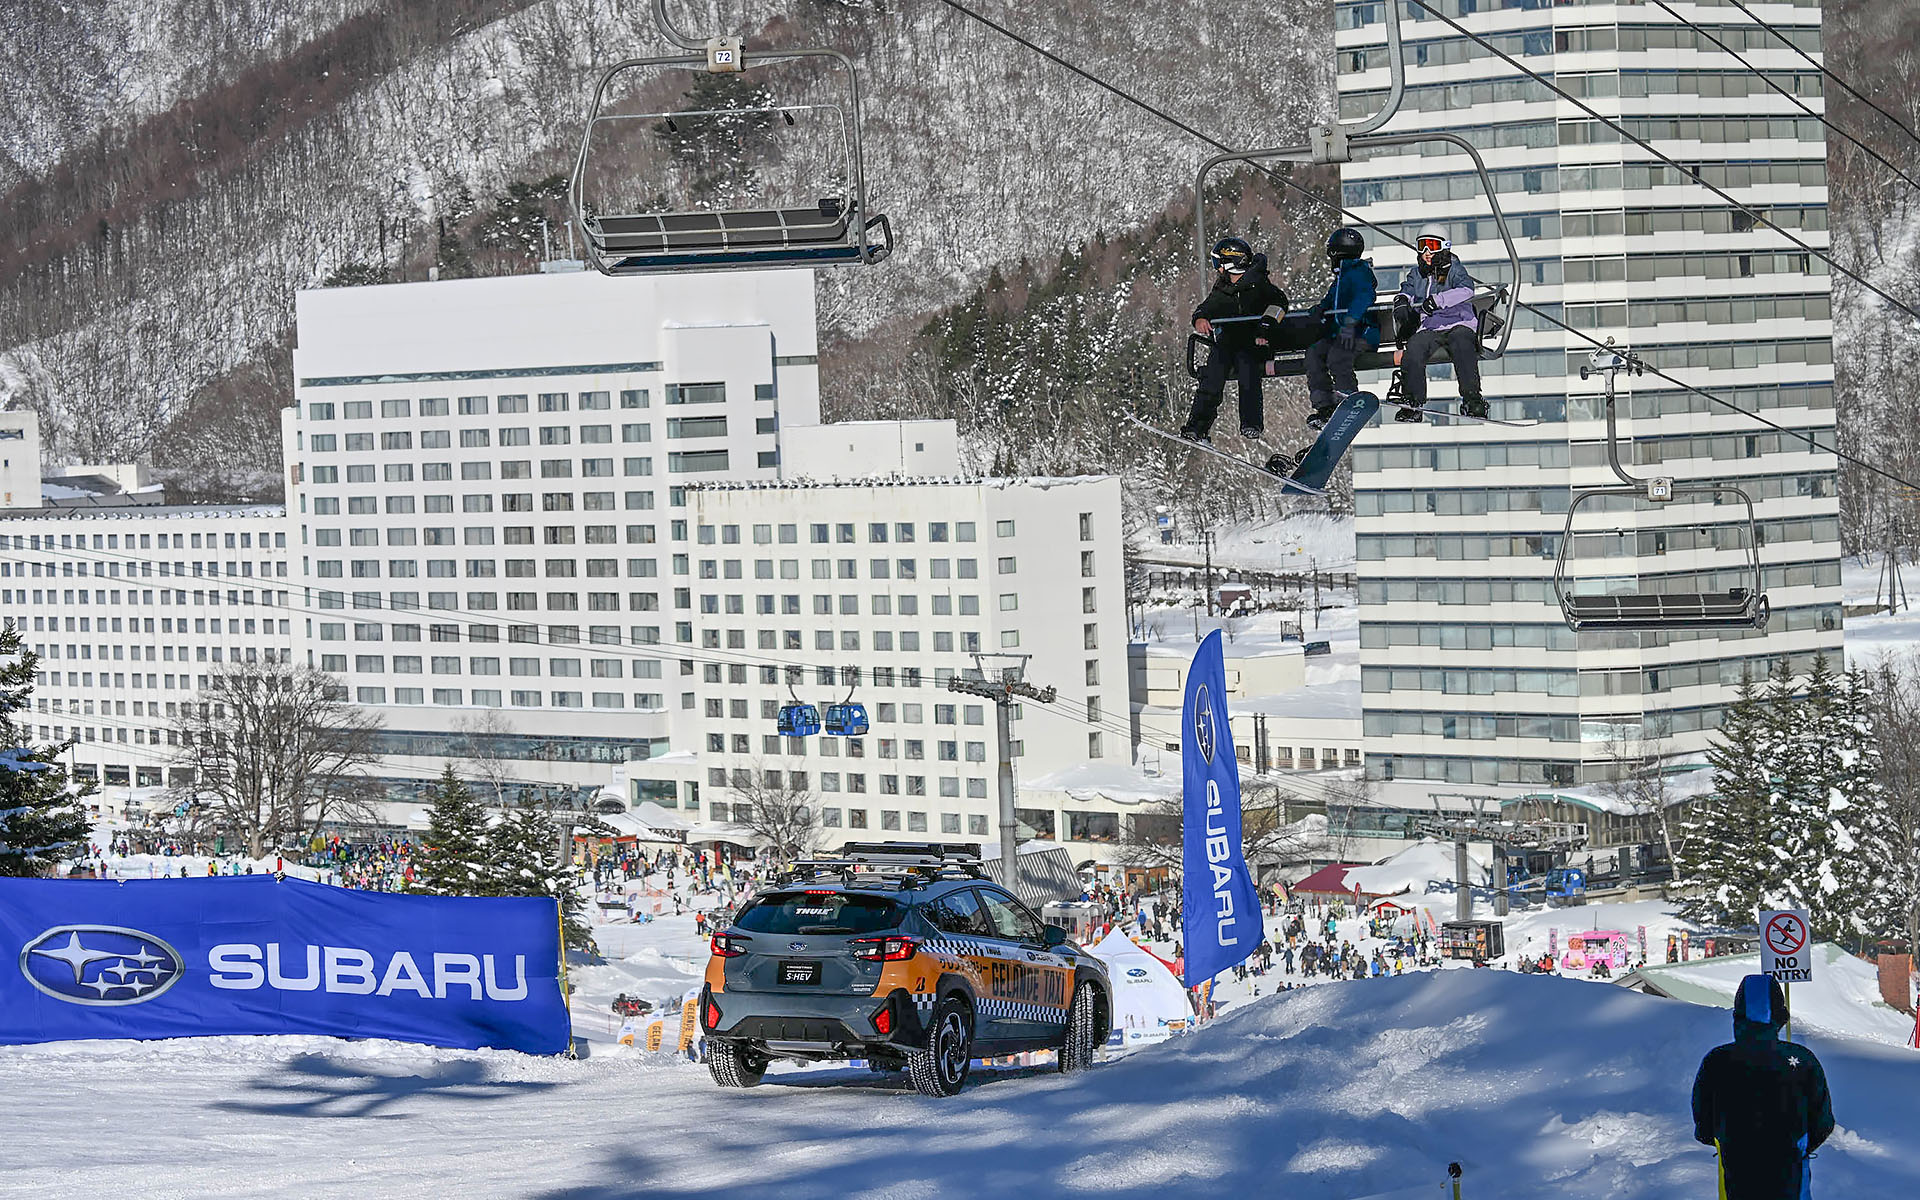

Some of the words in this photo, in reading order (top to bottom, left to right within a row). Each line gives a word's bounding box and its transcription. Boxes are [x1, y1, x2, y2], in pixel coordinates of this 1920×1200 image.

[718, 53, 730, 61] 72
[1206, 779, 1238, 947] SUBARU
[208, 943, 528, 1001] SUBARU
[1775, 957, 1798, 969] NO
[1044, 969, 1065, 1005] TAXI
